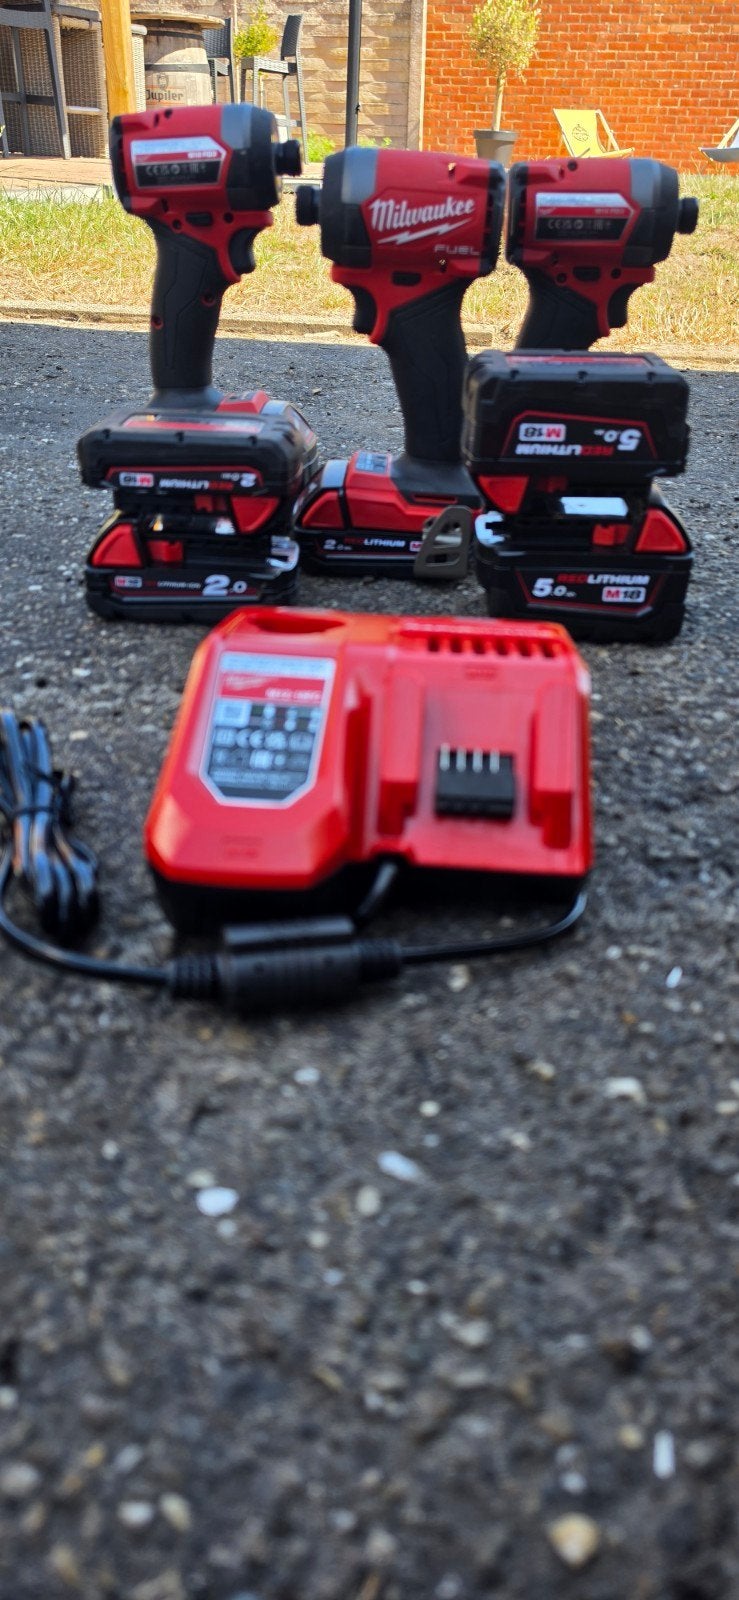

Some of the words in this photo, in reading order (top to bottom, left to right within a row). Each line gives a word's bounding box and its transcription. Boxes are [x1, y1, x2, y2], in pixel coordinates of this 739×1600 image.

[145, 89, 184, 102] Jupiler
[369, 196, 475, 232] Milwaukee
[434, 244, 480, 256] FUEL
[202, 574, 248, 596] 2.0
